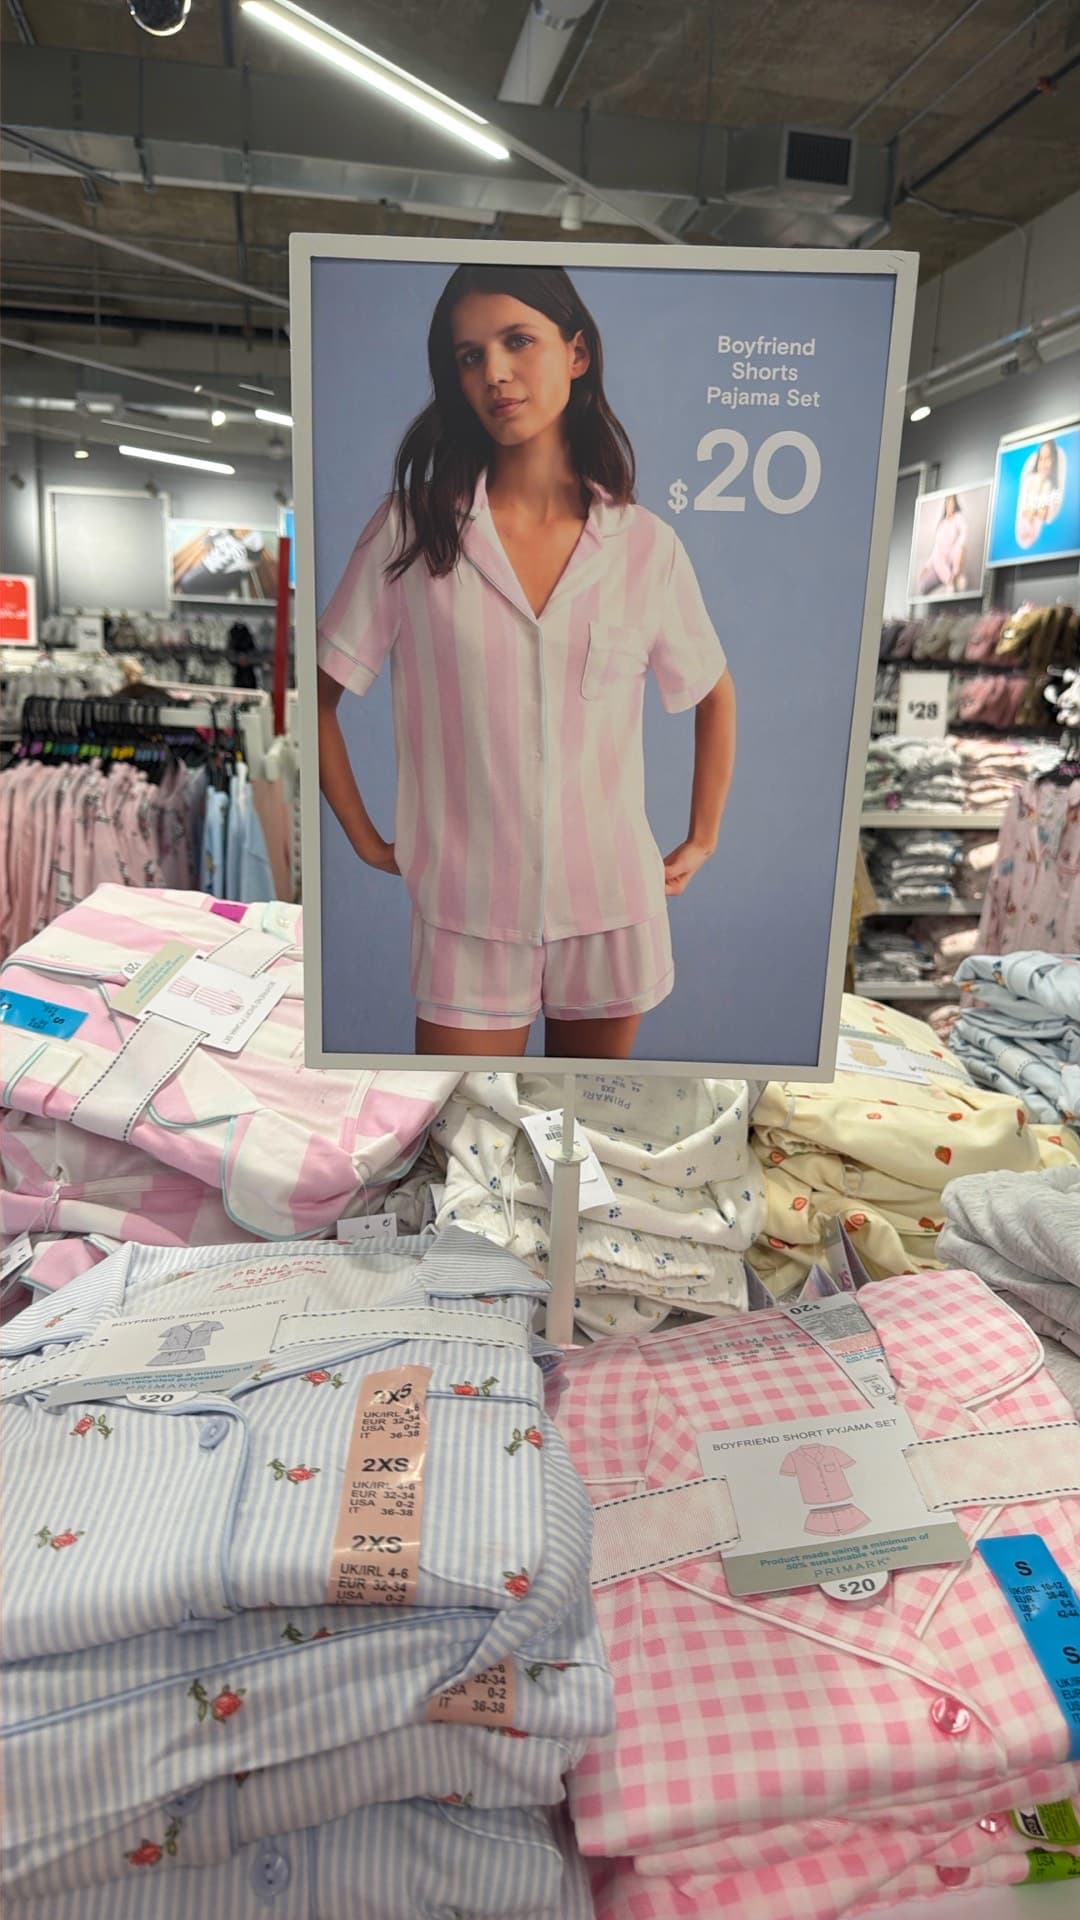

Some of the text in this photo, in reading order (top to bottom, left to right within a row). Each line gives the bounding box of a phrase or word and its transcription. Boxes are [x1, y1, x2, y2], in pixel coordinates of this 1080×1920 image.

[718, 335, 816, 358] Boyfriend
[732, 361, 798, 381] Shorts
[707, 386, 821, 409] Pajama Set
[668, 428, 822, 515] $20
[789, 1303, 821, 1316] $20
[139, 1393, 174, 1403] $20
[373, 1383, 413, 1405] 2XS
[363, 1410, 400, 1418] UK/IRL
[392, 1415, 420, 1425] 32-34
[390, 1430, 420, 1439] 36-38
[403, 1422, 420, 1431] 0-2
[711, 1417, 898, 1452] BOYFRIEND SHORT PYJAMA SET
[362, 1457, 410, 1473] 2XS
[351, 1490, 415, 1500] EUR 32-34
[396, 1483, 416, 1491] 4-6
[348, 1506, 414, 1517] IT 36-38
[350, 1499, 415, 1508] USA 0-2
[351, 1534, 403, 1554] 2XS
[759, 1555, 801, 1567] Product
[801, 1551, 830, 1561] made
[870, 1535, 917, 1549] minimum
[918, 1532, 930, 1542] of
[809, 1551, 868, 1568] sustainable
[869, 1544, 909, 1556] viscose
[340, 1562, 409, 1580] UK/IRL 4-6
[814, 1558, 886, 1578] PRIMARK
[1014, 1560, 1033, 1577] S
[338, 1576, 407, 1593] EUR 32-34
[838, 1578, 876, 1596] $20
[336, 1590, 406, 1603] USA 0-2
[1062, 1645, 1080, 1665] S
[487, 1686, 507, 1700] 0-2
[439, 1696, 506, 1714] IT 36-38
